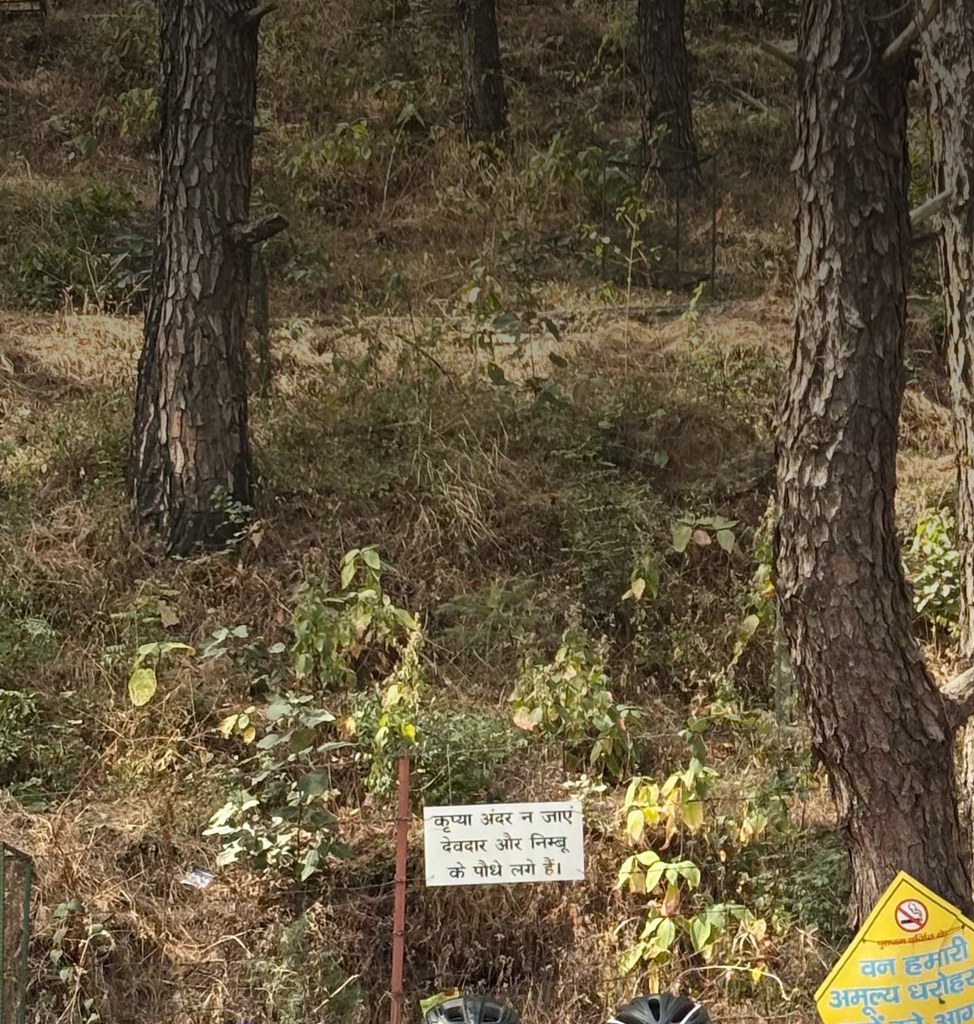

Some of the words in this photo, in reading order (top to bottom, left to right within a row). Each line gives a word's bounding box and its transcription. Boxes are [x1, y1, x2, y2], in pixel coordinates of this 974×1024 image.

[433, 813, 472, 832] कृप्या
[481, 808, 513, 826] अंदर
[520, 811, 533, 823] न
[540, 806, 573, 824] जाएं
[440, 836, 487, 853] देवदार
[495, 832, 522, 851] और
[530, 832, 570, 853] निम्बू
[448, 861, 465, 878] के
[473, 859, 502, 878] पौधे
[510, 858, 536, 875] लगे
[860, 958, 896, 978] वन
[903, 936, 969, 977] हमारी
[828, 985, 900, 1017] अमूल्य
